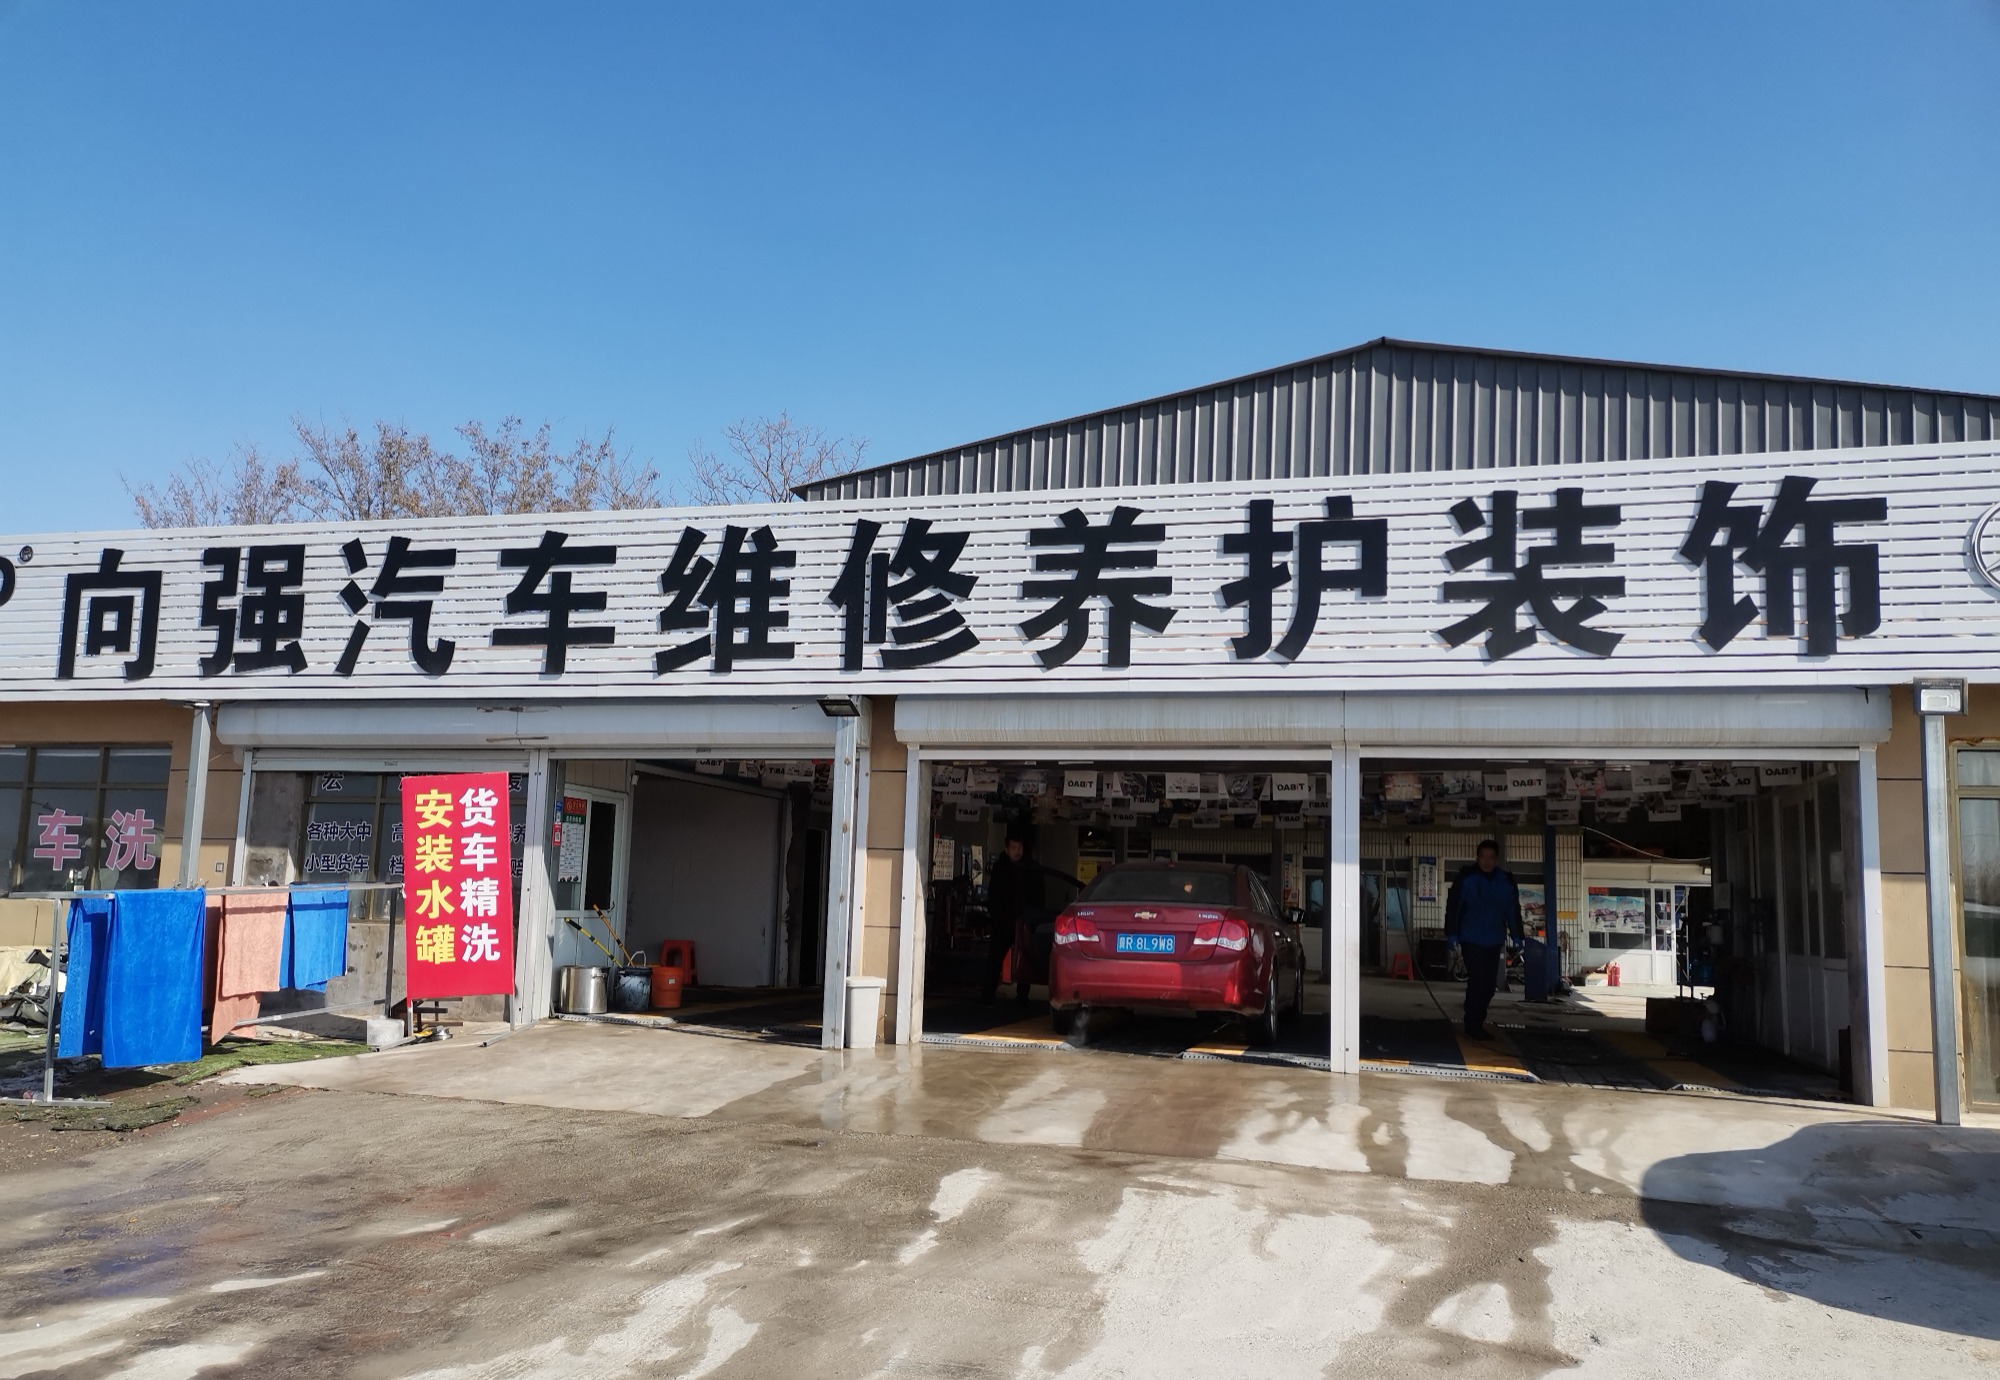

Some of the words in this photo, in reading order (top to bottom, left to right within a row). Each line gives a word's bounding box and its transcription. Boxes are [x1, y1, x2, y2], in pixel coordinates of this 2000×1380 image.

[58, 475, 1887, 682] 向强汽车维修养护装饰
[305, 853, 369, 874] 小型货车
[307, 821, 372, 842] 各种大中
[414, 789, 456, 965] 安装水罐
[459, 788, 500, 963] 货车精洗
[510, 823, 526, 845] 养
